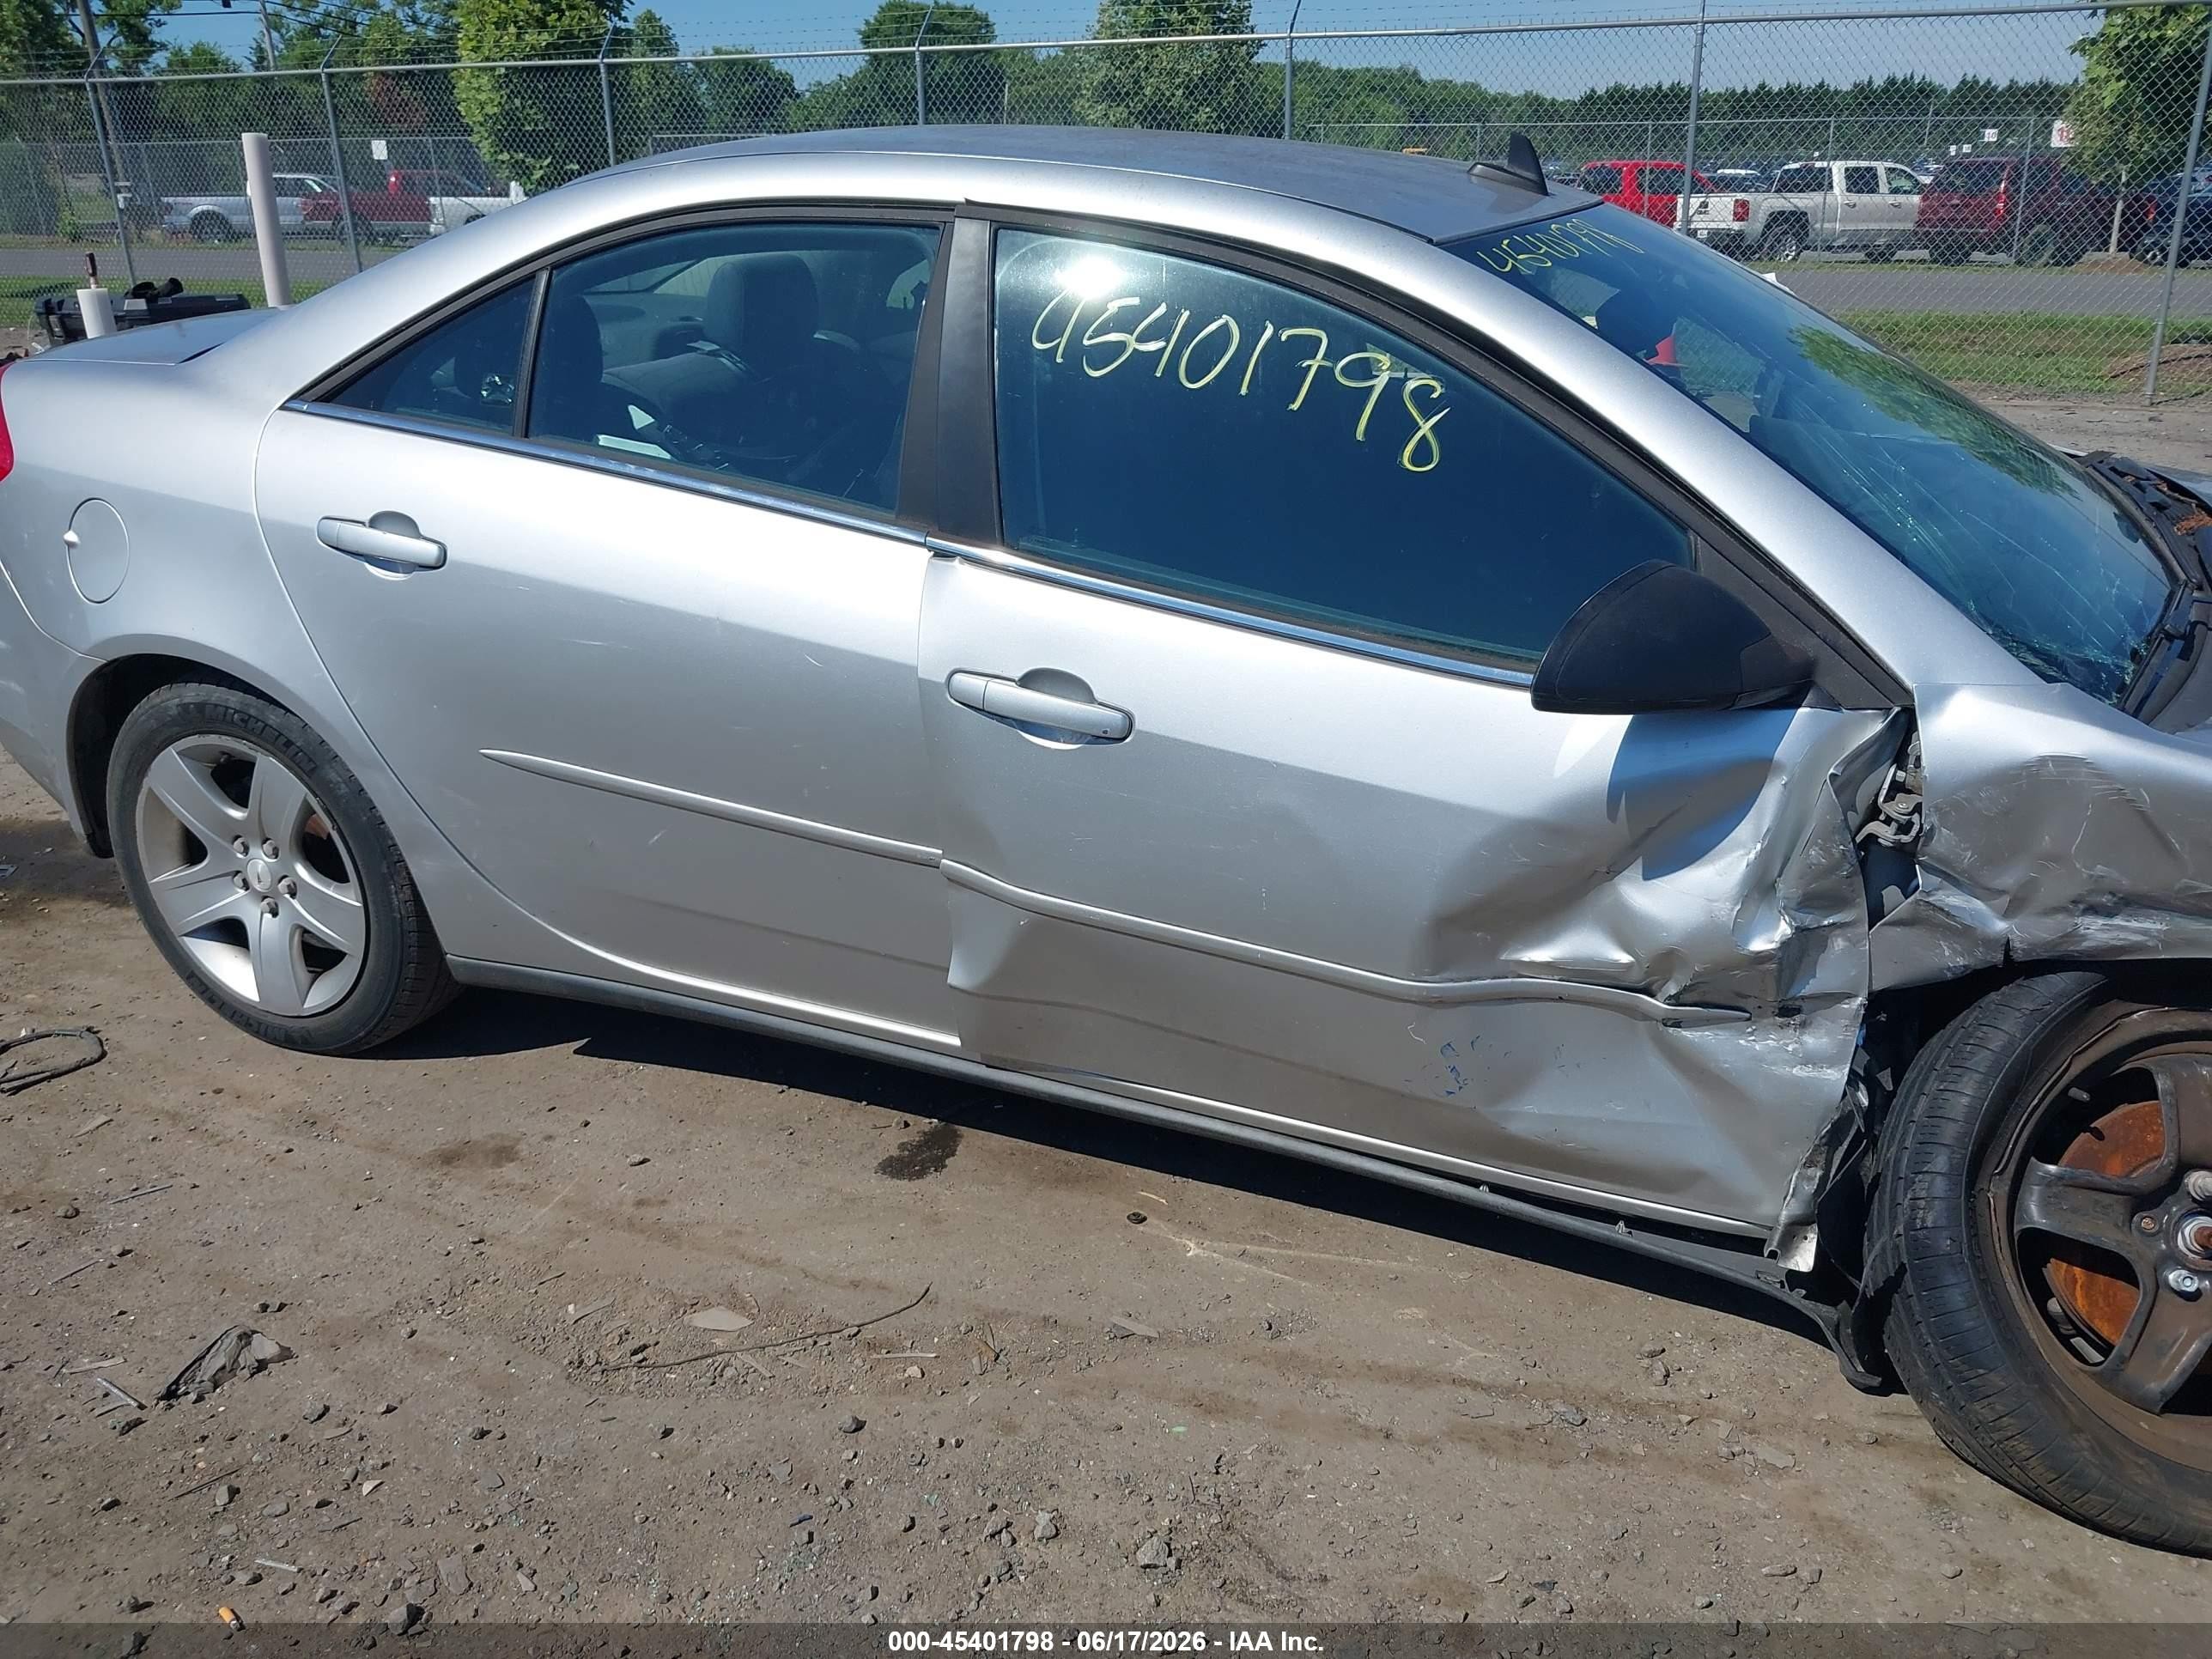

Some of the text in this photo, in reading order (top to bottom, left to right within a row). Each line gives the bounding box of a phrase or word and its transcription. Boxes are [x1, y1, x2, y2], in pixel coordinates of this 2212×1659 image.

[1476, 218, 1645, 275] 45401798
[1030, 289, 1451, 473] 45401798
[204, 702, 318, 775] MICHELIN
